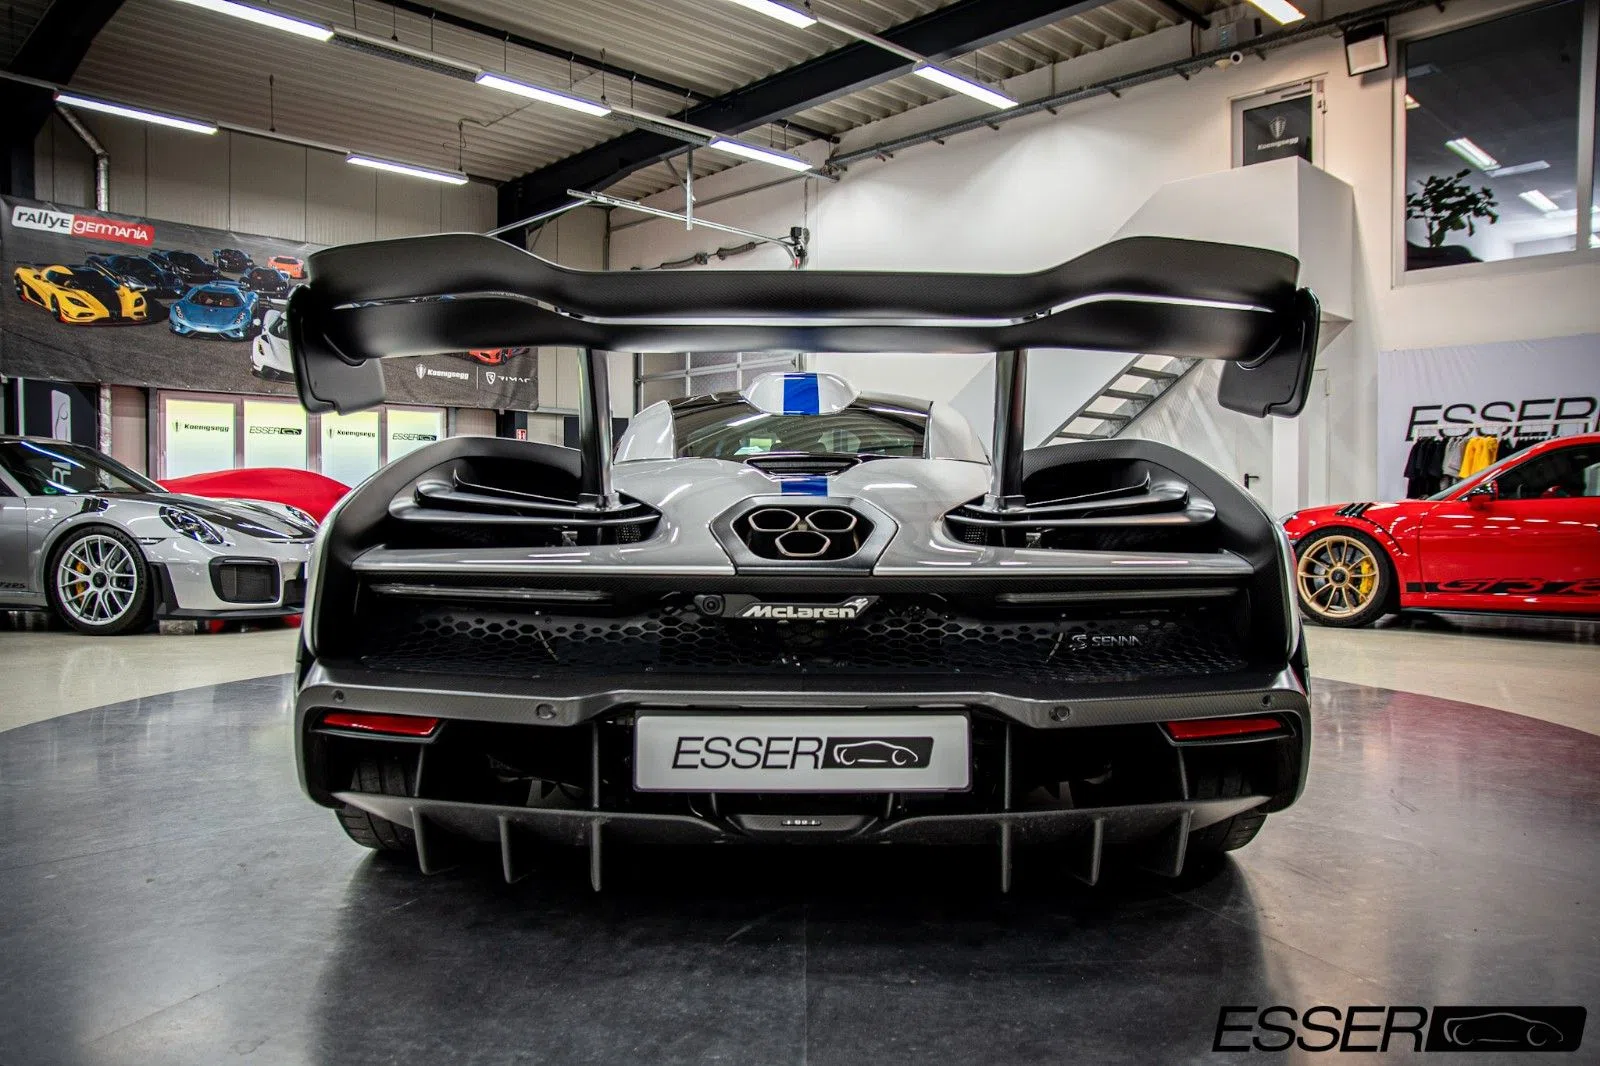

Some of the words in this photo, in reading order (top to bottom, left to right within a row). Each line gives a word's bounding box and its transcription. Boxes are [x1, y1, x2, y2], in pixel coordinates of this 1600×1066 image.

[427, 368, 469, 380] Koenigsegg
[1405, 396, 1598, 442] ESSER
[184, 423, 230, 433] Koenigsegg
[249, 425, 281, 434] ESSER
[392, 432, 419, 441] ESSER
[742, 605, 856, 618] McLaren
[1092, 635, 1142, 647] SENNA
[671, 736, 824, 770] ESSER
